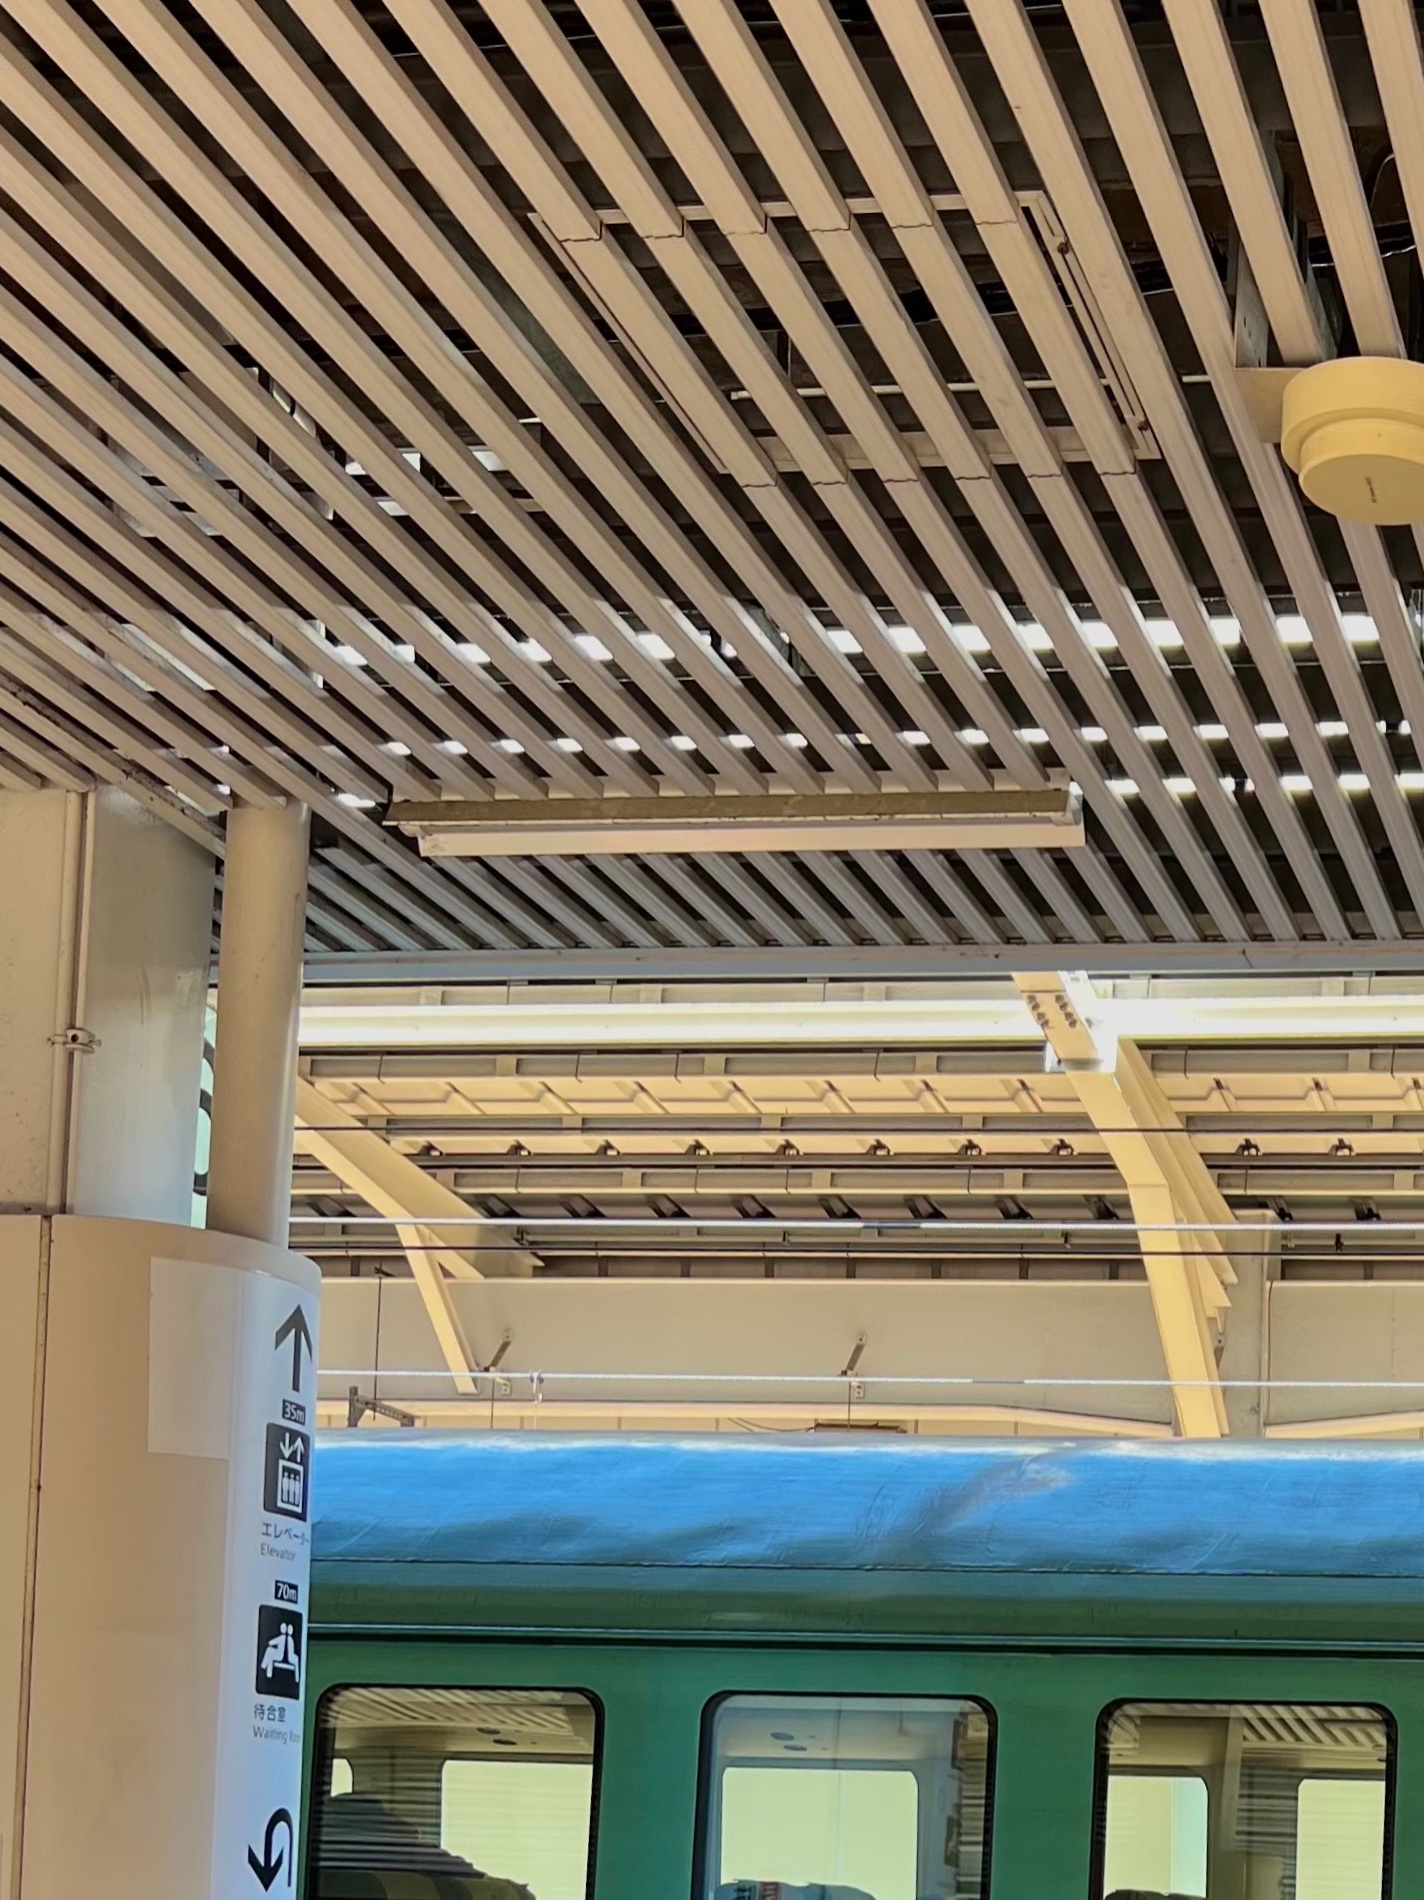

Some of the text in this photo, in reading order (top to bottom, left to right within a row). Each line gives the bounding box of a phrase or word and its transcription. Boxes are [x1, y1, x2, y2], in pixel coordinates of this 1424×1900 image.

[284, 1402, 305, 1424] 35m
[260, 1542, 297, 1561] Elevator
[276, 1582, 297, 1602] 70m
[253, 1703, 287, 1723] 待合室
[252, 1725, 288, 1745] Waiting
